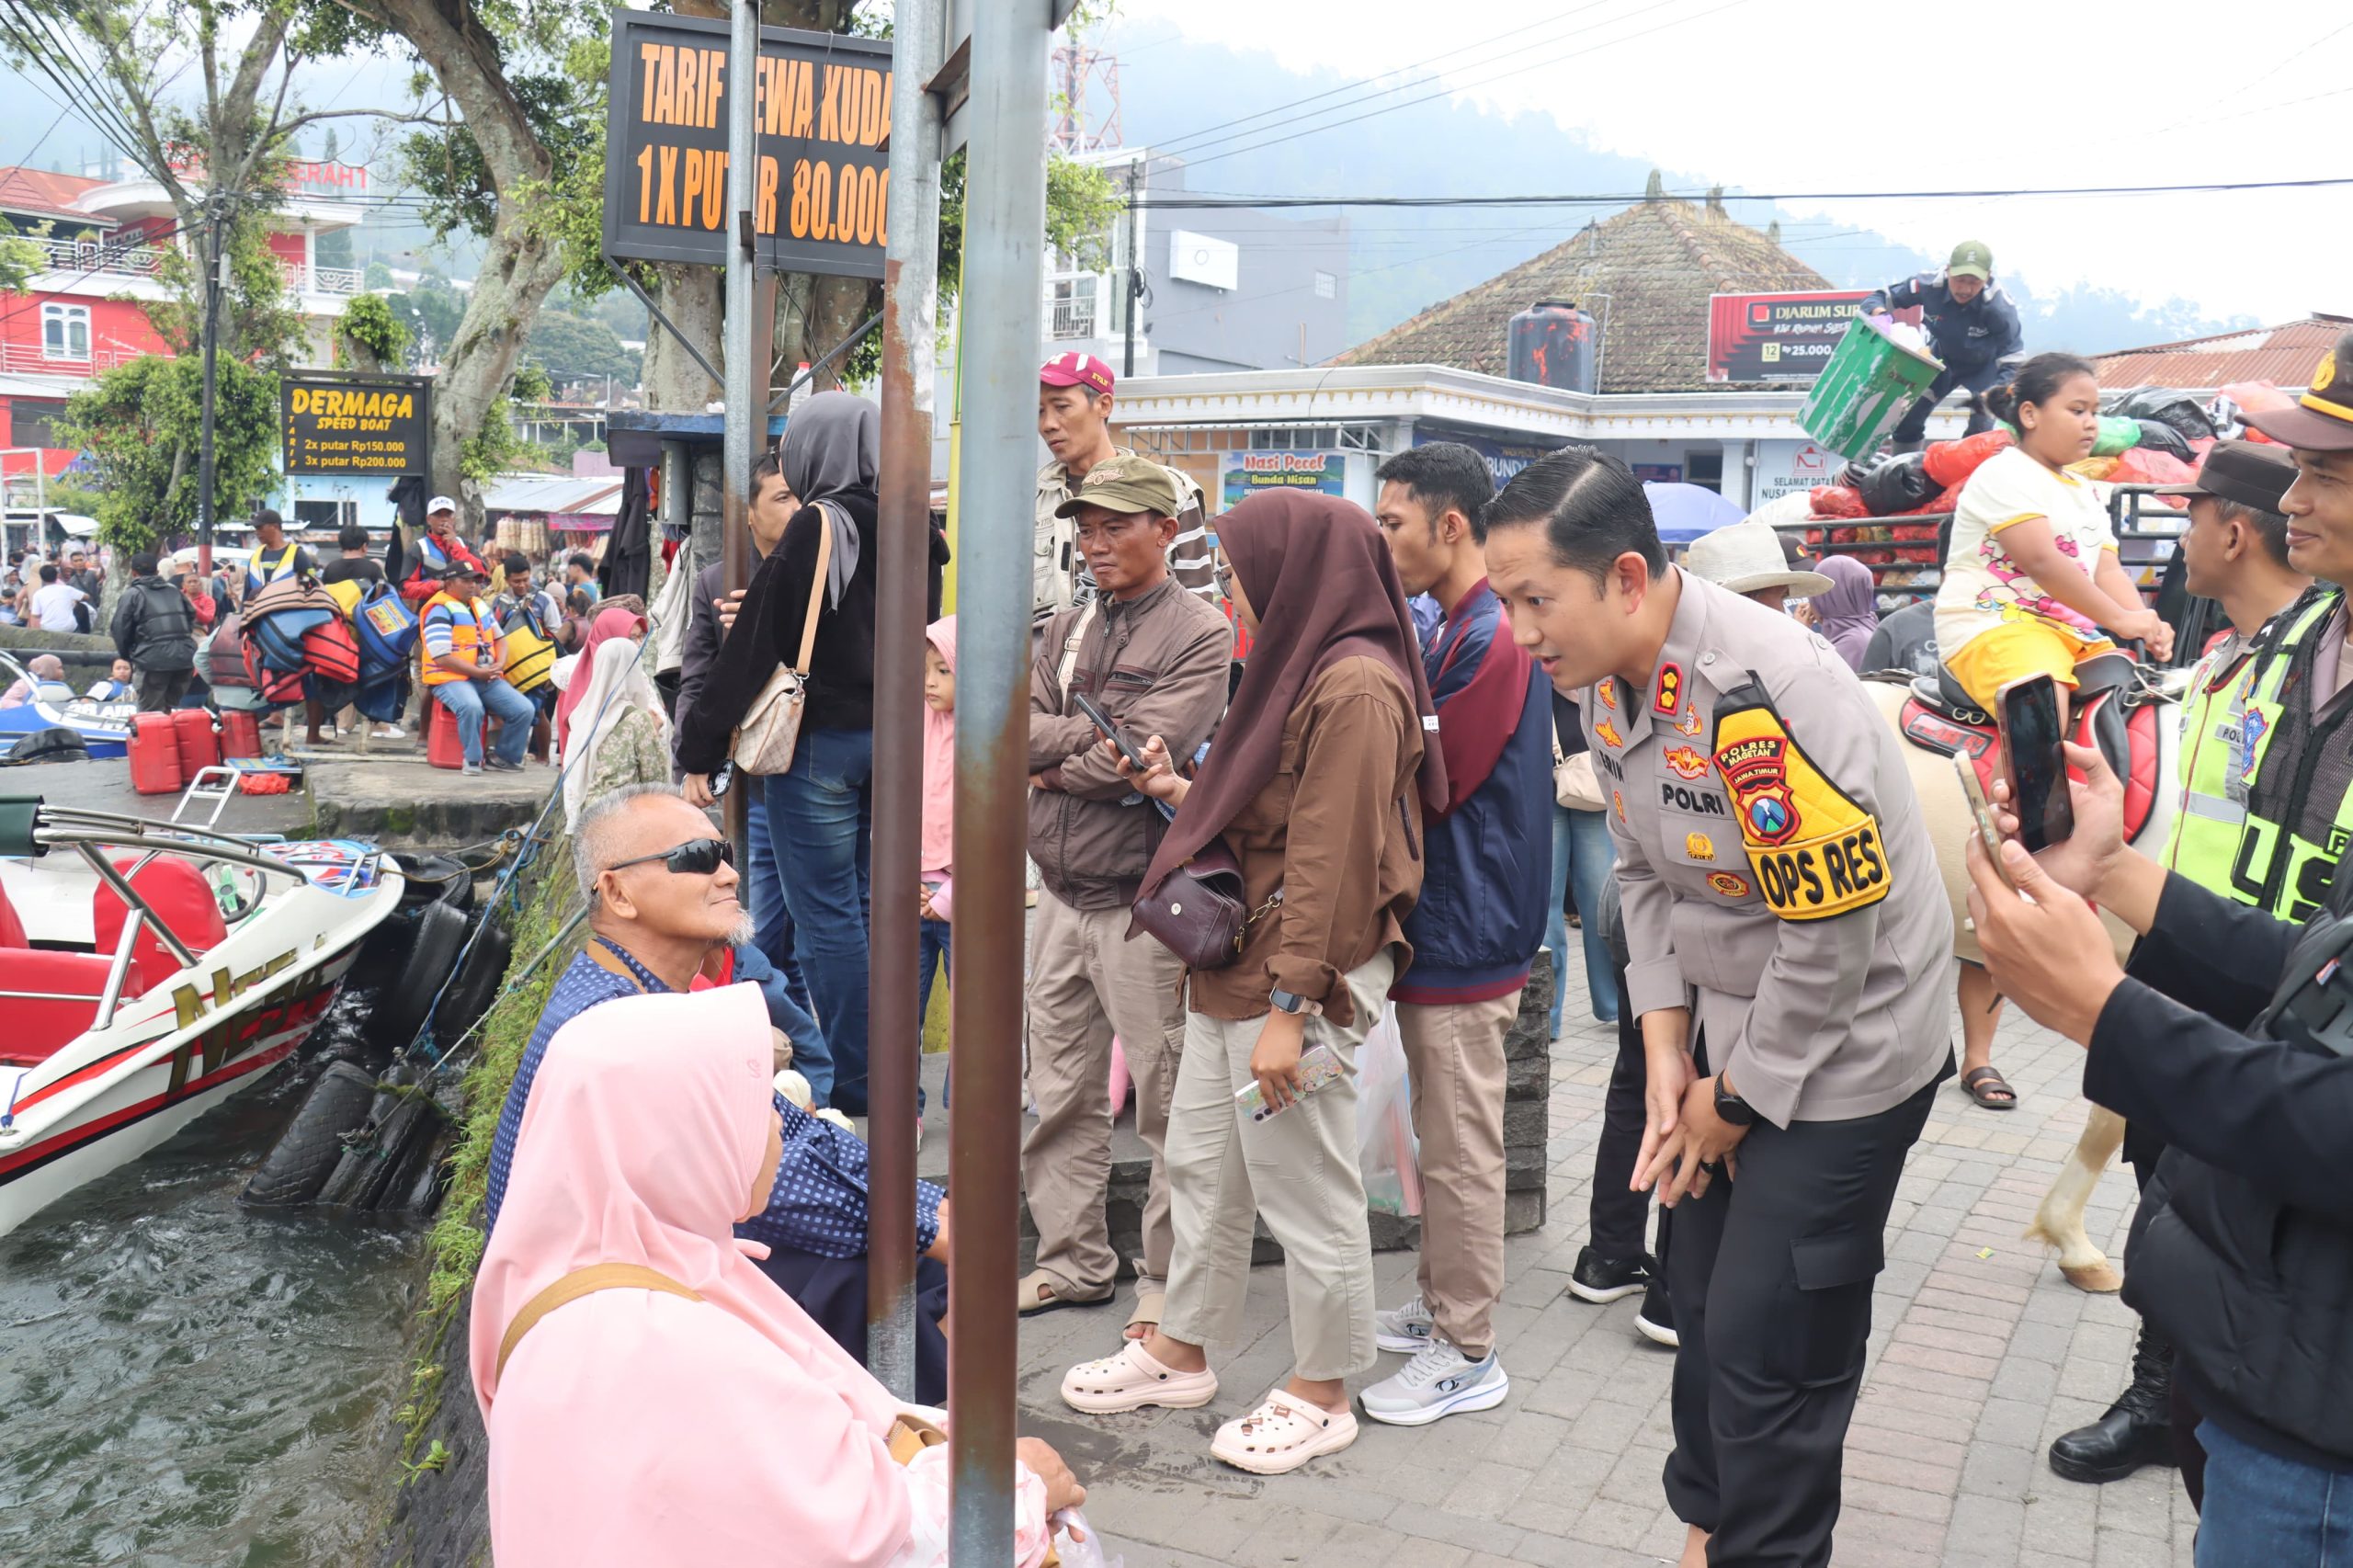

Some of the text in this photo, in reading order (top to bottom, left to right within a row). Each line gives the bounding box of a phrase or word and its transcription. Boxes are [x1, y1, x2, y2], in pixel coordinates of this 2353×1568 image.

[641, 42, 725, 129] TARIF
[753, 56, 813, 140] EWA
[682, 148, 779, 234] PUR
[1776, 304, 1860, 319] DJARUM SUP
[1765, 346, 1777, 356] 12
[291, 388, 413, 418] DERMAGA
[316, 417, 392, 431] SPEED BOAT
[304, 438, 404, 452] 2x putar Rp150.000
[304, 455, 406, 468] 3x putar Rp200.000
[1245, 454, 1324, 471] Nasi Pecel
[1251, 474, 1316, 484] Bunda Nisan
[1774, 477, 1808, 486] SELAMAT
[1720, 741, 1776, 763] POLRES
[1728, 749, 1771, 767] MAGETAN
[1661, 783, 1725, 816] POLRI
[1760, 828, 1883, 908] OPS RES
